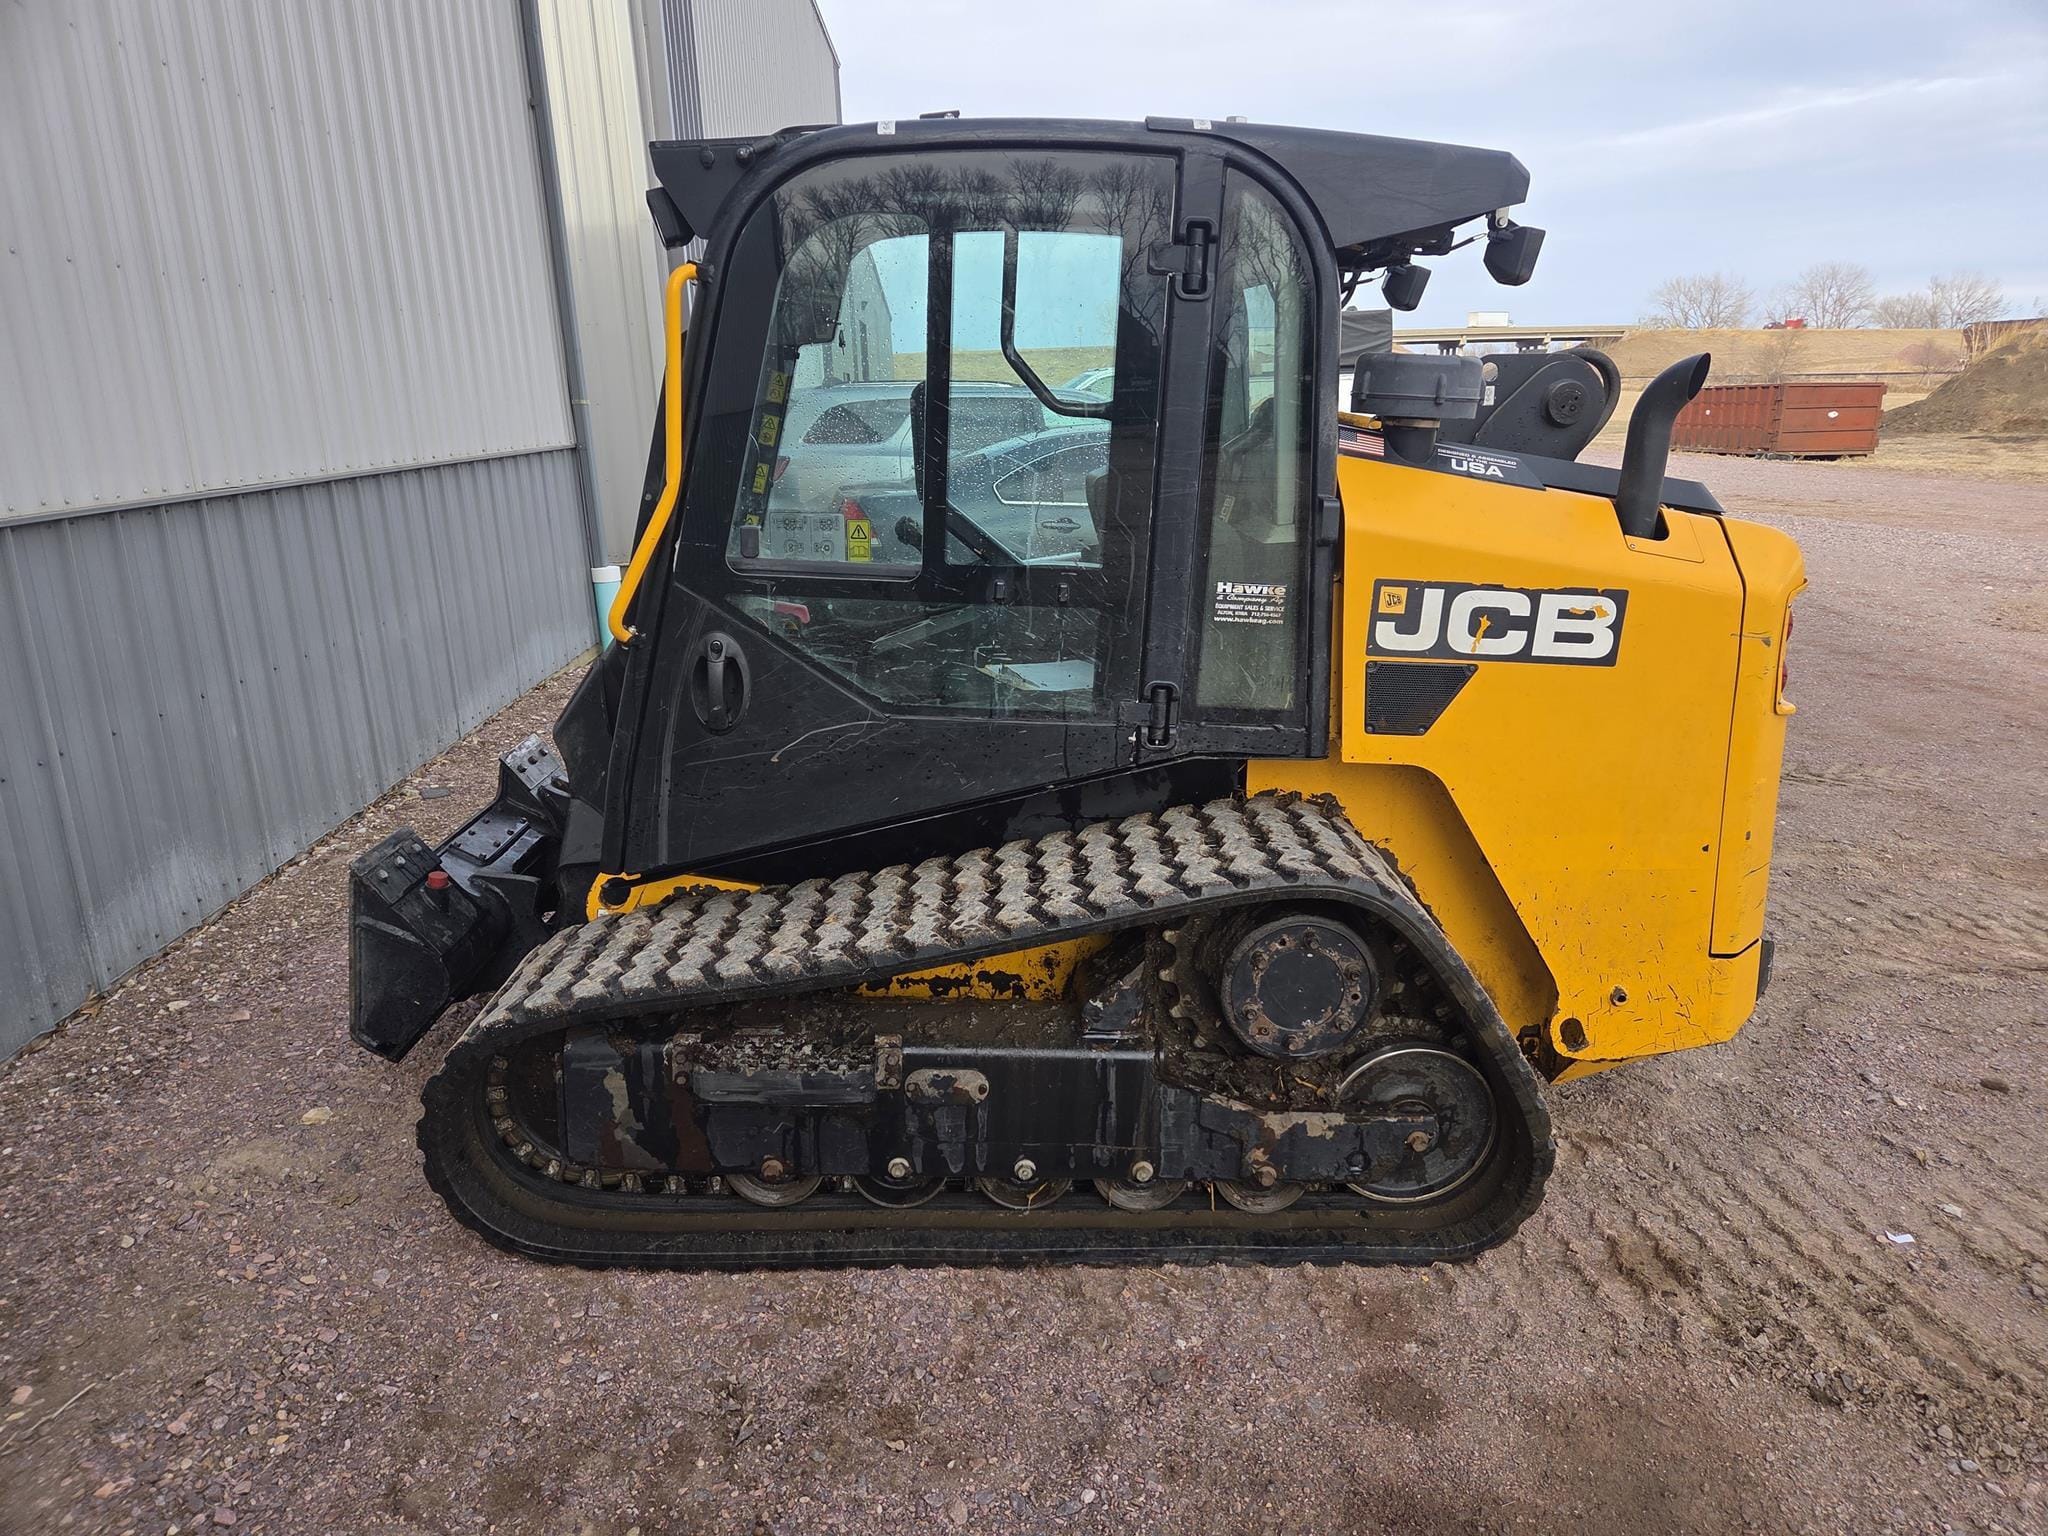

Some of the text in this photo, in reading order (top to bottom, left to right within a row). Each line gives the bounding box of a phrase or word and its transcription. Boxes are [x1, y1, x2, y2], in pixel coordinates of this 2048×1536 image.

[1437, 448, 1470, 457] DESIGNED
[1477, 455, 1517, 466] ASSEMBLED
[1451, 458, 1505, 478] USA
[1217, 582, 1287, 596] Hawke
[1226, 593, 1268, 604] Company
[1386, 593, 1402, 607] JCB
[1375, 588, 1617, 659] JCB
